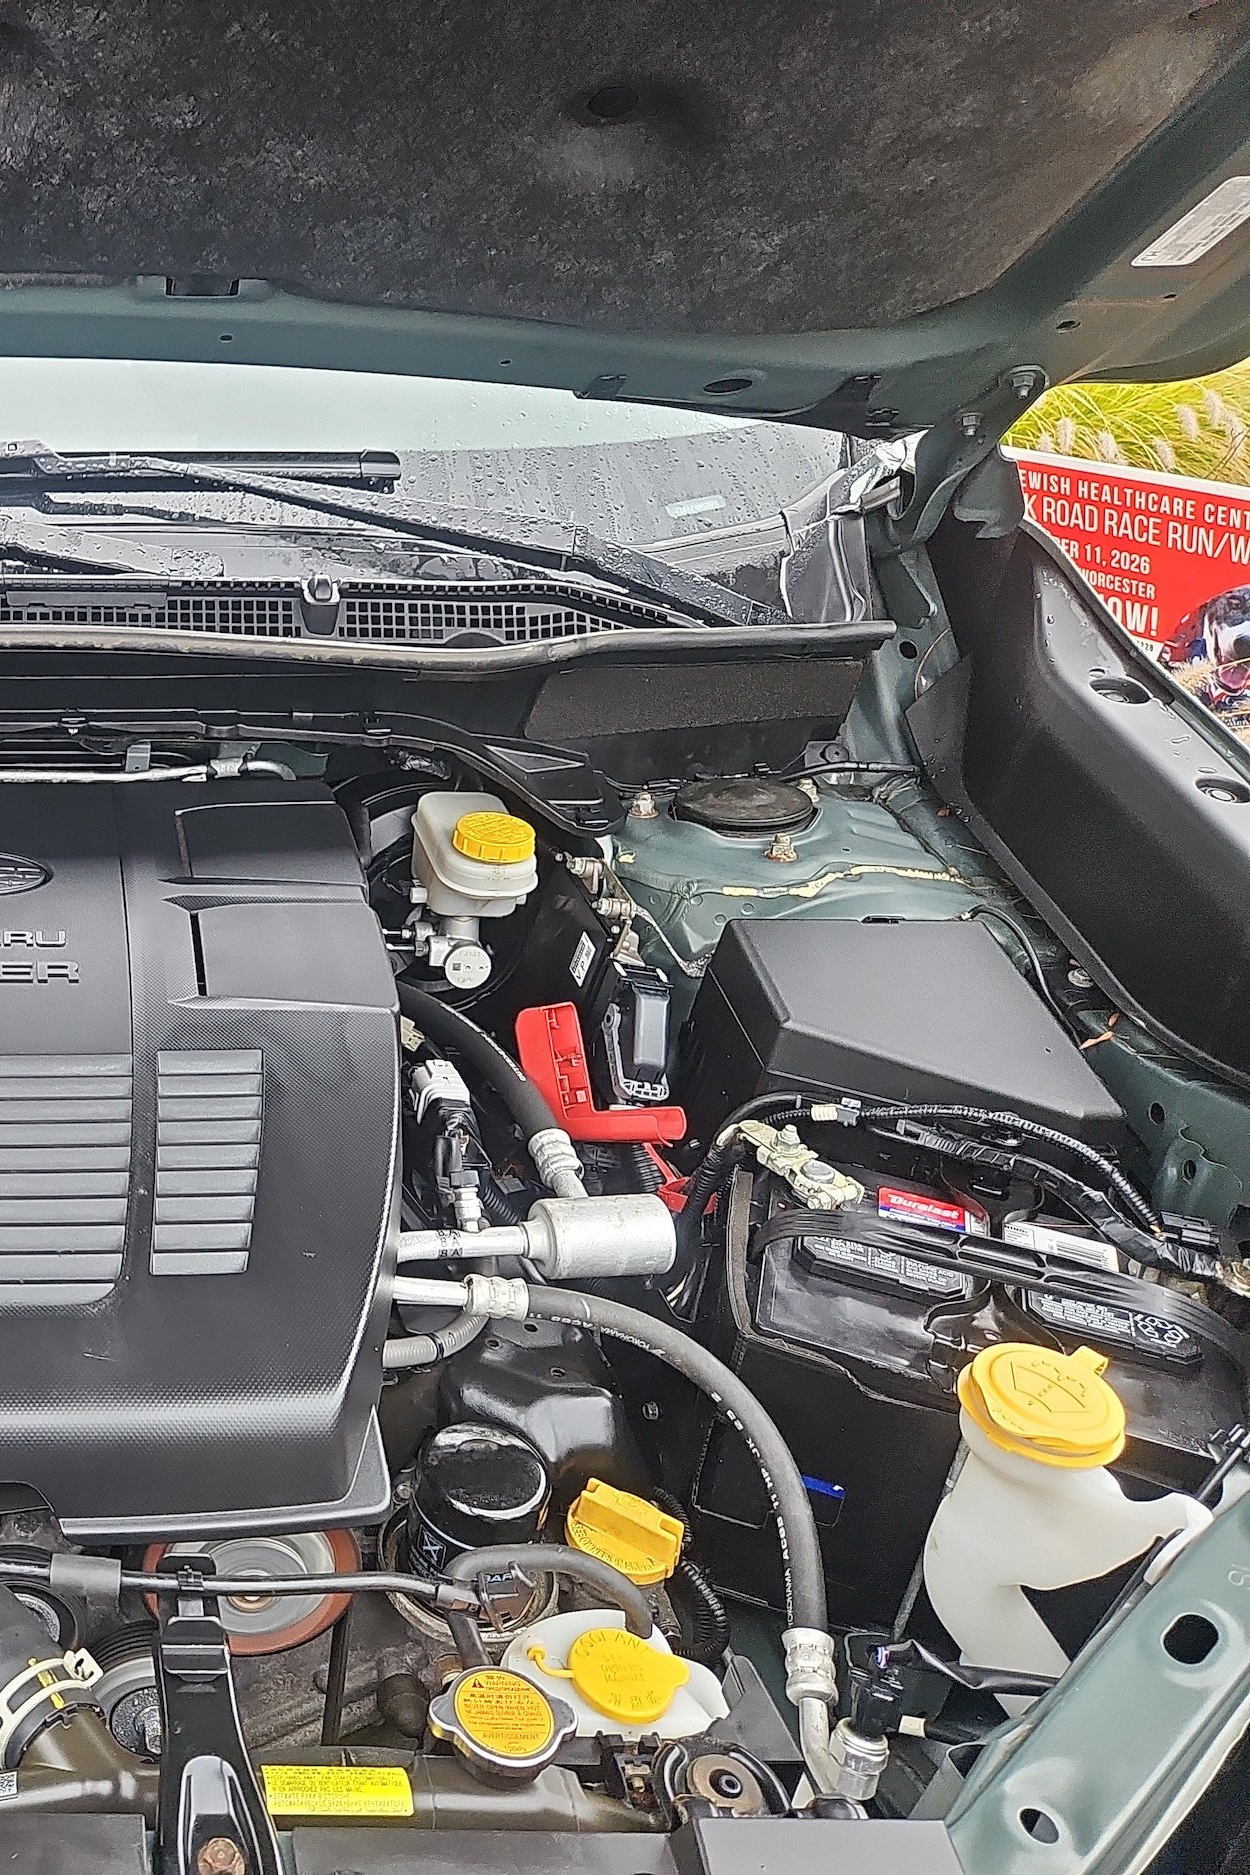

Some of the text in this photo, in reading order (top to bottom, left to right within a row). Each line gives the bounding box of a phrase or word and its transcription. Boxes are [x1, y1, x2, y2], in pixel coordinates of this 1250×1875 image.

[1019, 468, 1071, 497] EWISH
[1078, 479, 1196, 520] HEALTHCARE
[1043, 496, 1098, 532] ROAD
[1104, 508, 1161, 546] RACE
[1084, 543, 1107, 567] 11,
[1110, 549, 1151, 575] 2026
[1099, 593, 1159, 637] OW!
[887, 1194, 959, 1220] Duralast
[600, 1326, 651, 1352] YOKOHAMA
